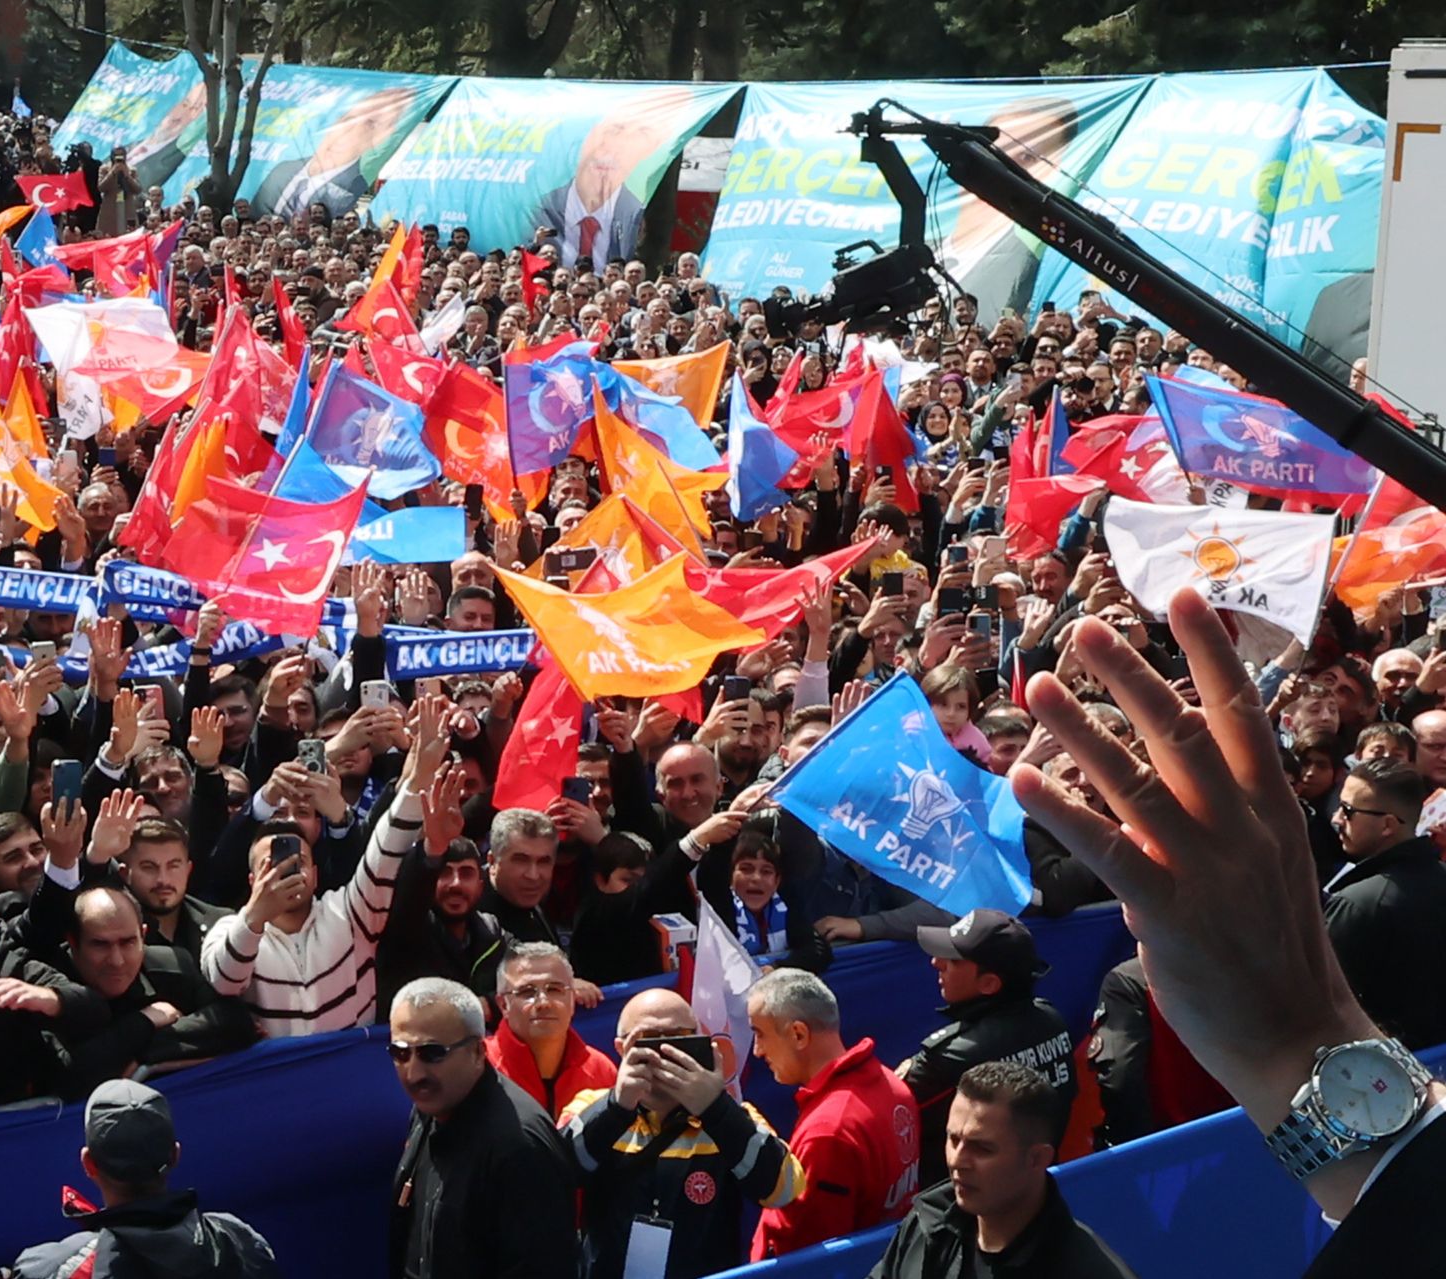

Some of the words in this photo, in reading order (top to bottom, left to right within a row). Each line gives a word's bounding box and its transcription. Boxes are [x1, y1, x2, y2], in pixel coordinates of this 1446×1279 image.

[1100, 141, 1358, 215] GERÇEK
[771, 250, 792, 264] ALİ
[1069, 236, 1130, 284] Altus
[765, 263, 804, 280] GÜNER
[548, 433, 571, 455] AK
[1212, 455, 1242, 478] AK
[1250, 458, 1315, 485] PARTİ
[396, 639, 431, 672] AK
[588, 651, 622, 674] AK
